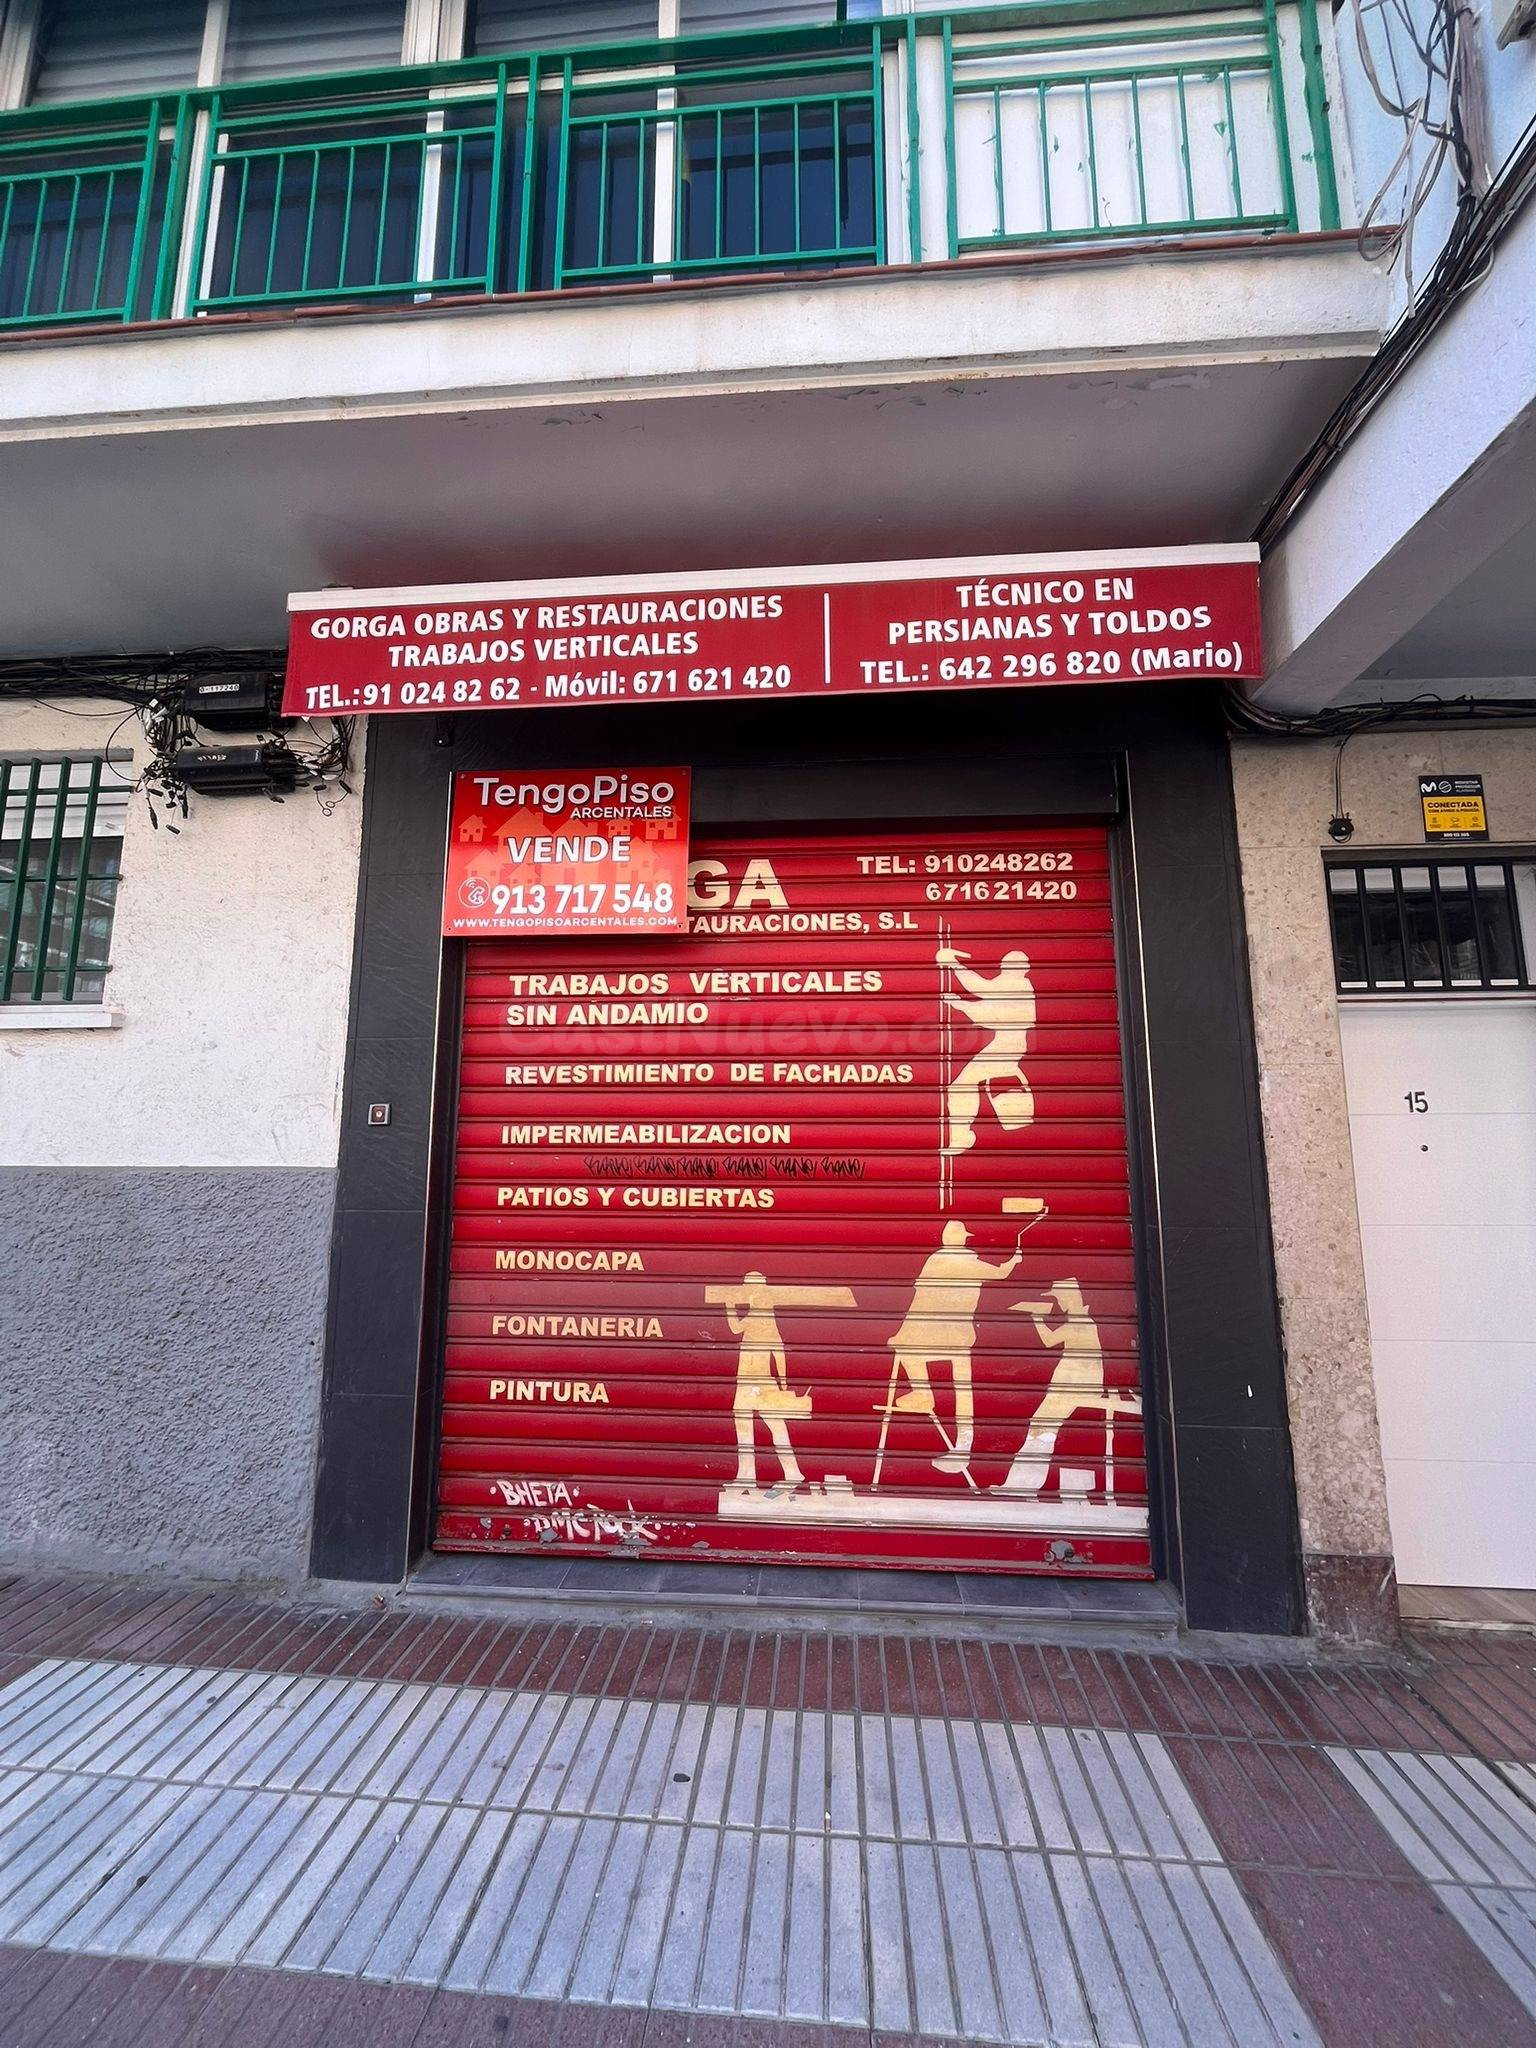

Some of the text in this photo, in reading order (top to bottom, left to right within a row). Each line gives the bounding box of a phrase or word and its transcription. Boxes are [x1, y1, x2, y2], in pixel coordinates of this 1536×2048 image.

[956, 577, 1133, 608] TÉCNICO EN
[311, 595, 783, 639] GORGA OBRAS Y RESTAURACIONES
[889, 606, 1212, 644] PERSIANAS Y TOLDOS
[389, 631, 698, 668] TRABAJOS VERTICALES
[860, 642, 1243, 684] TEL.: 642 296 820 (Mario)
[401, 682, 445, 705] 024
[453, 680, 481, 703] 82
[490, 677, 519, 701] 62
[545, 671, 625, 697] Móvil:
[632, 670, 678, 693] 671
[687, 668, 732, 690] 621
[743, 665, 791, 688] 420
[474, 774, 674, 814] TengoPiso
[571, 806, 672, 819] ARCENTALES
[508, 835, 631, 863] VENDE
[857, 852, 1073, 874] TEL: 910248262
[492, 883, 673, 914] 913 717 548
[453, 916, 677, 928] WWW.TENGOPISOARCENTALES.COM
[879, 912, 918, 929] S.L
[509, 970, 882, 996] TRABAJOS VERTICALES
[507, 1003, 709, 1026] SIN ANDAMIO
[505, 1063, 913, 1085] REVESTIMIENTO DE FACHADAS
[1404, 1091, 1428, 1113] 15
[502, 1125, 790, 1144] IMPERMEABILIZACION
[498, 1186, 775, 1208] PATIOS Y CUBIERTAS
[495, 1250, 645, 1271] MONOCAPA
[492, 1315, 663, 1337] FONTANERIA
[490, 1380, 609, 1403] PINTURA
